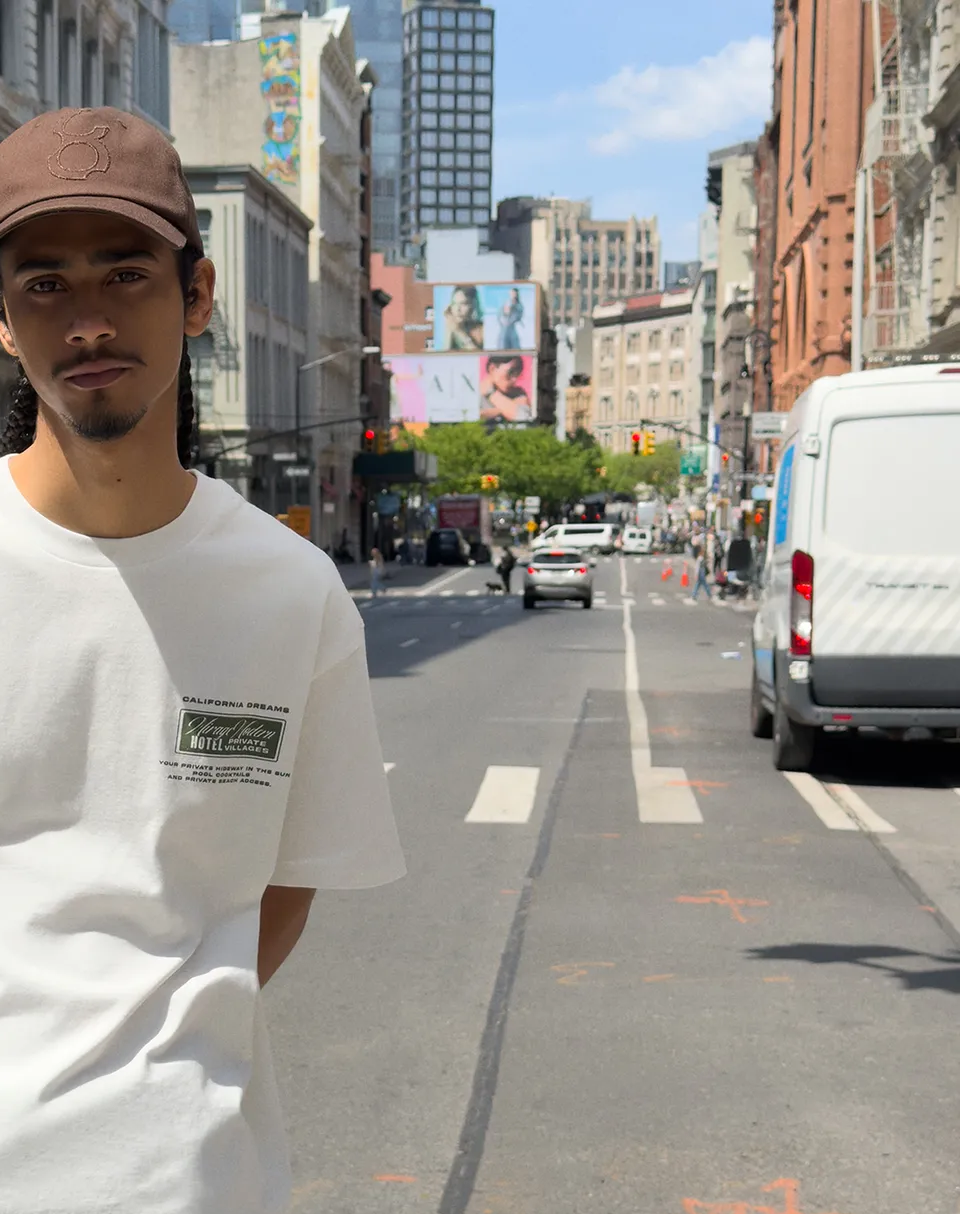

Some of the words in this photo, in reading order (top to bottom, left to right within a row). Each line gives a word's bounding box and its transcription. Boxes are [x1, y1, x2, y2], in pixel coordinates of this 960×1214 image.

[182, 696, 244, 708] CALIFORNIA
[246, 702, 290, 713] DREAMS
[190, 735, 223, 751] HOTEL
[228, 738, 267, 747] PRIVATE
[224, 745, 269, 754] VILLAGES
[181, 763, 214, 771] PRIVATE
